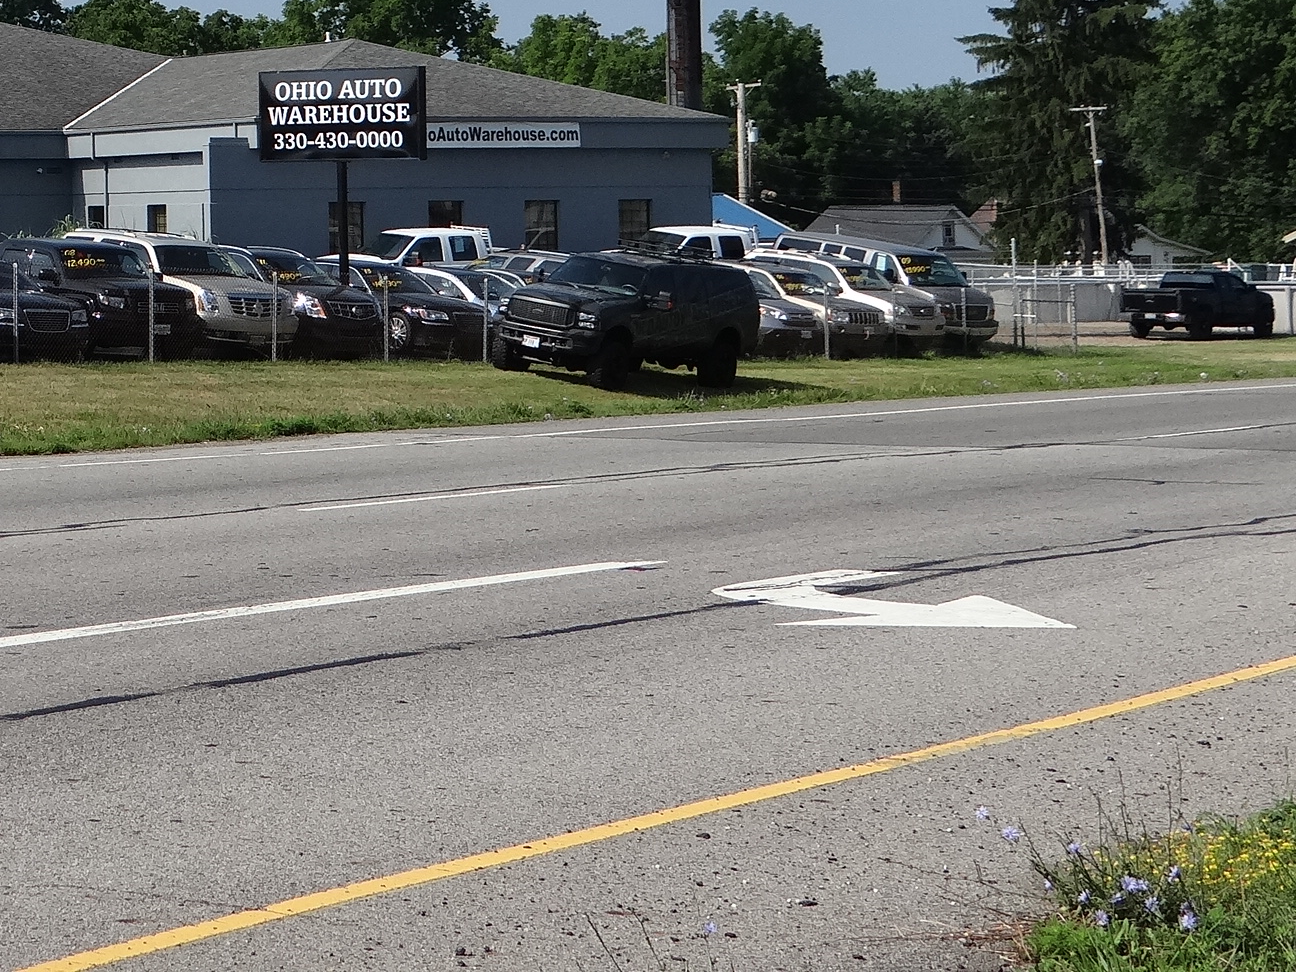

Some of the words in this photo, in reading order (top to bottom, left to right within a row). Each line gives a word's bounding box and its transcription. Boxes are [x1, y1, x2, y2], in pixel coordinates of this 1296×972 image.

[274, 80, 332, 101] OHIO
[338, 78, 402, 99] AUTO
[267, 103, 410, 125] WAREHOUSE
[274, 130, 404, 150] 330-430-0000
[427, 126, 579, 142] oAutoWarehouse.com
